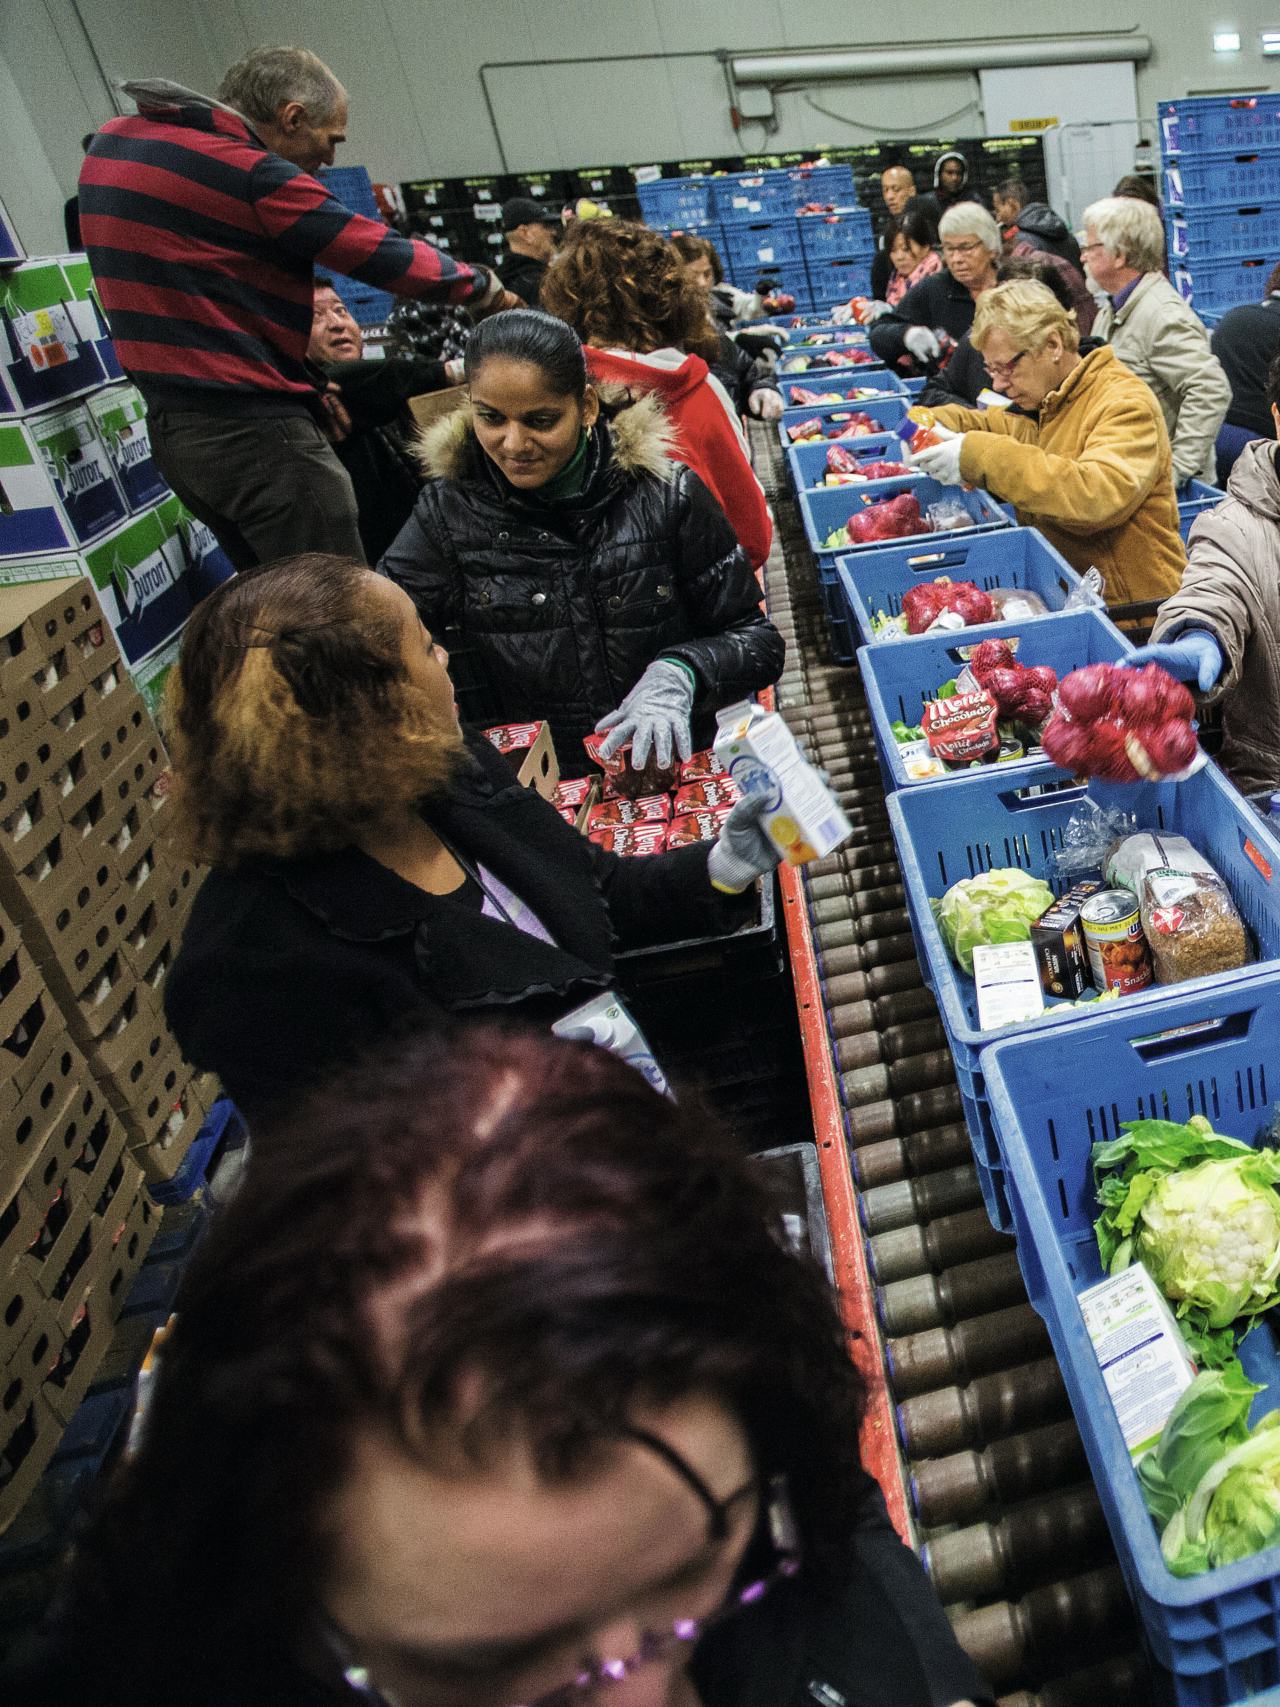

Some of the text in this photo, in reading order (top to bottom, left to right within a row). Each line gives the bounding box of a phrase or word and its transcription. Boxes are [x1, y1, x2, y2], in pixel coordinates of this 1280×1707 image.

[69, 459, 101, 489] DUTOIT
[133, 560, 167, 599] DUTOIT
[929, 691, 988, 720] Mona
[931, 704, 991, 729] Chocolade
